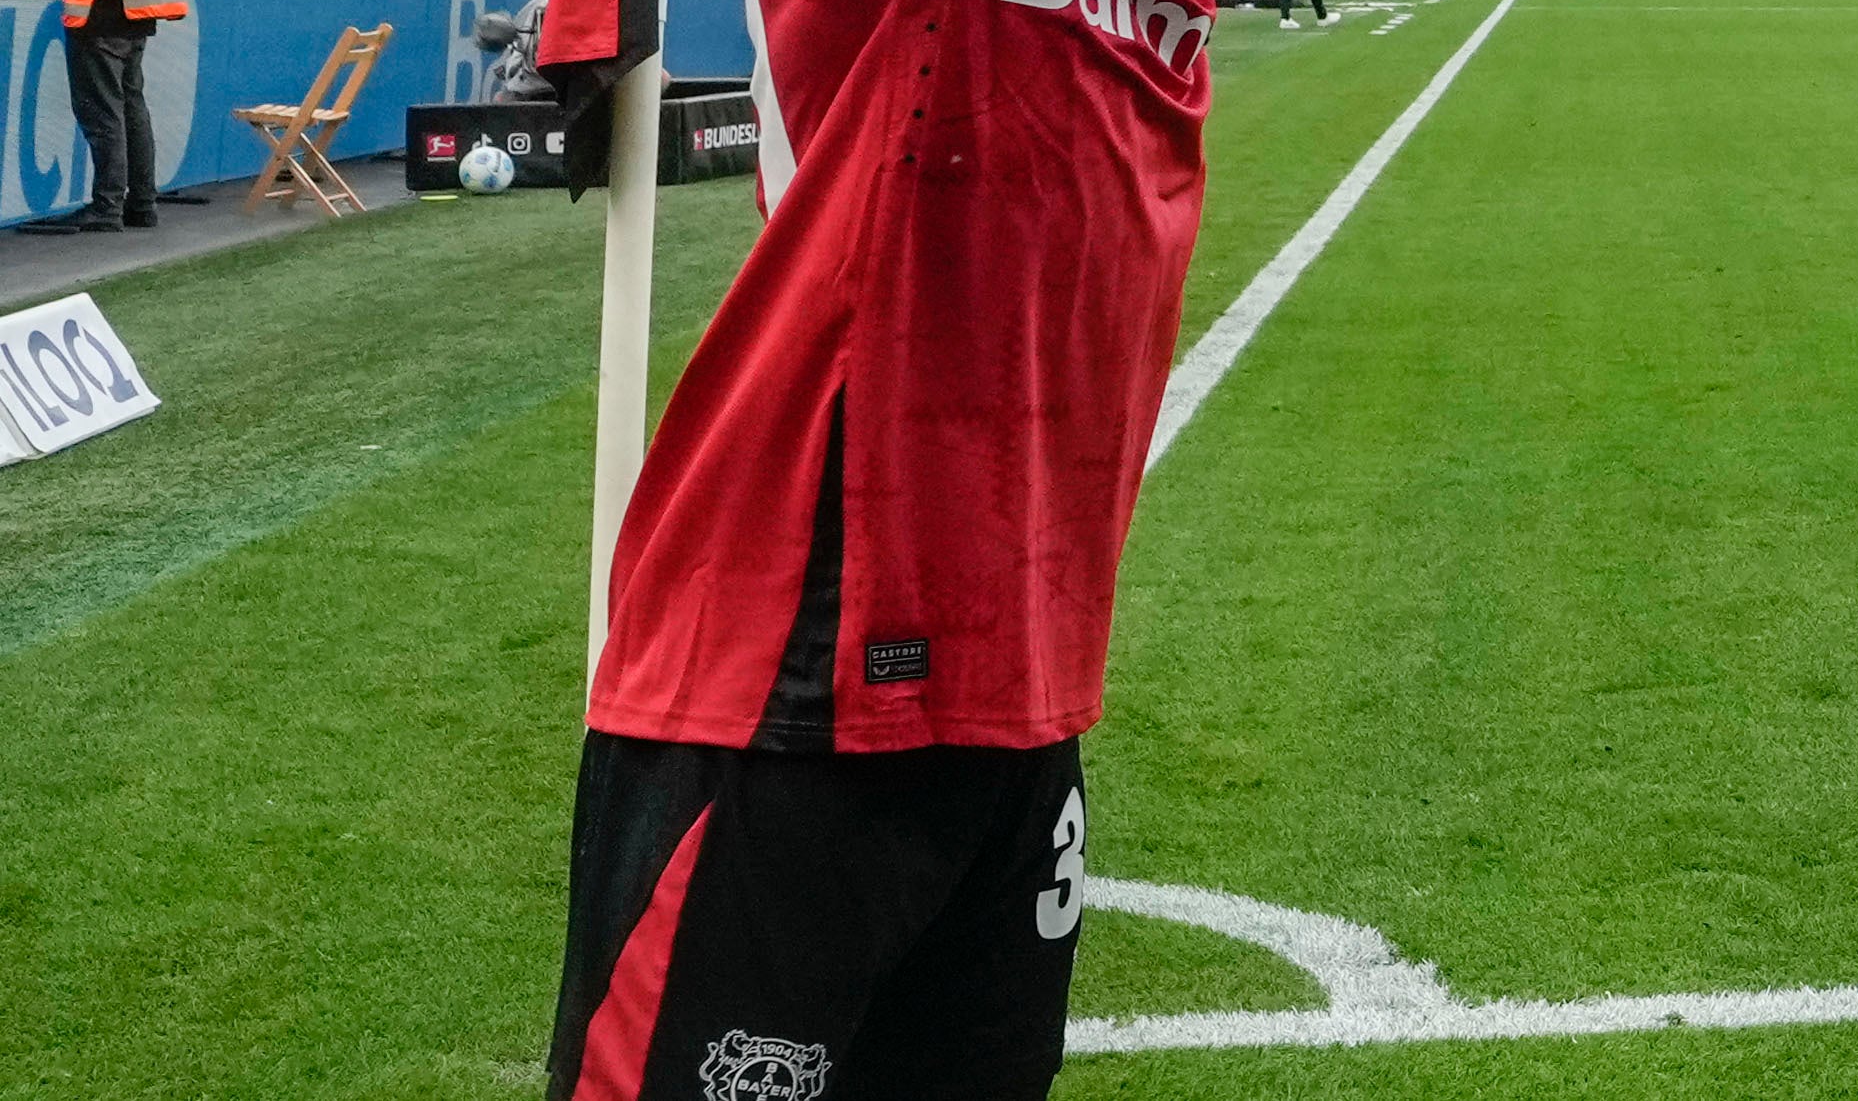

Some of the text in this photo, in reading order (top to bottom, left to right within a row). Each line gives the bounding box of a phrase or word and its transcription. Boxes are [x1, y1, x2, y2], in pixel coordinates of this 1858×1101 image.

[704, 122, 761, 150] BUNDESL
[1036, 786, 1085, 940] 3
[761, 1043, 793, 1058] 1904
[737, 1078, 792, 1098] BAYER
